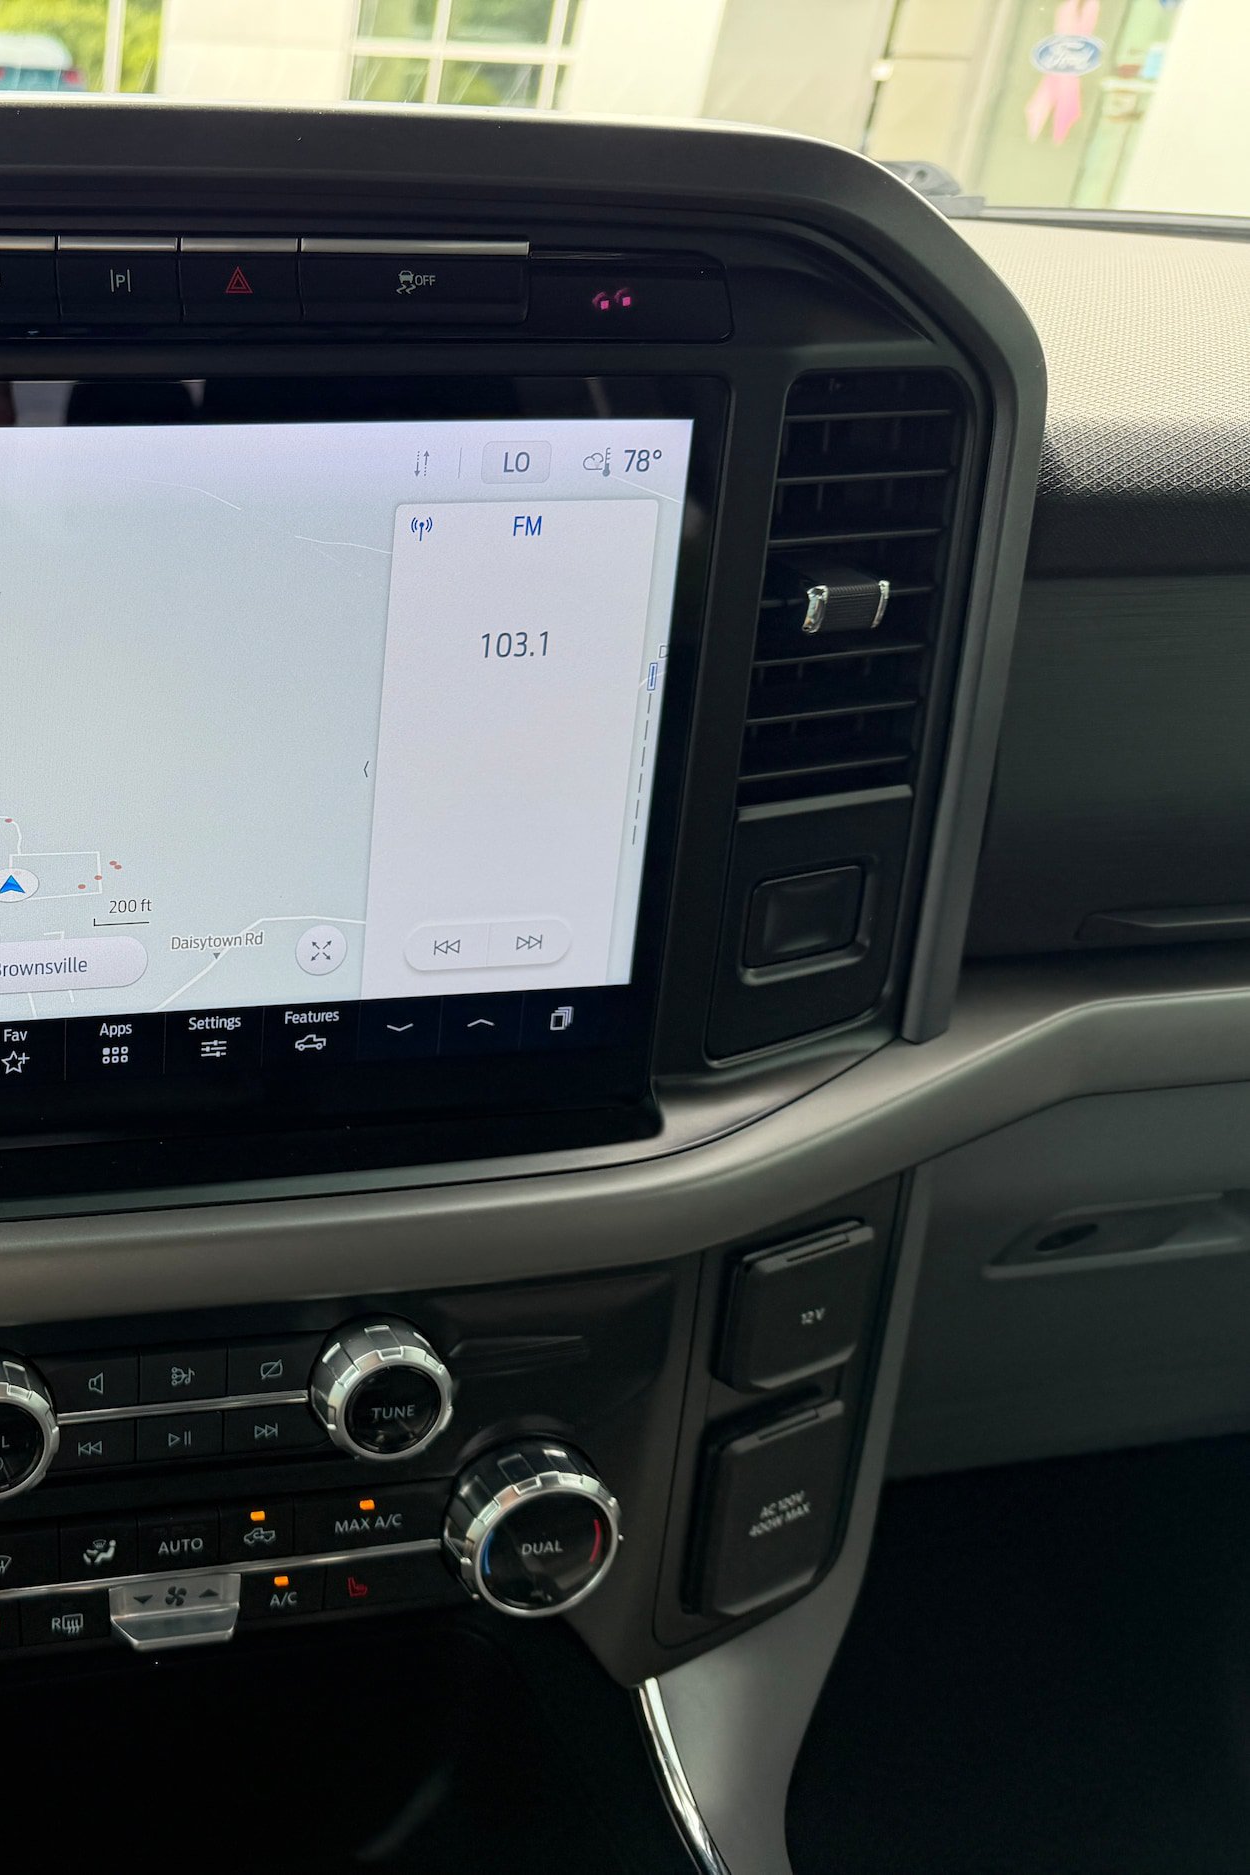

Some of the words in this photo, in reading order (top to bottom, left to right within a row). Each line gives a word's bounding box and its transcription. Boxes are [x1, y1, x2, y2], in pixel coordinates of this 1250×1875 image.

[414, 274, 436, 286] OFF
[503, 451, 530, 473] LO
[624, 449, 663, 473] 78°
[512, 515, 543, 537] FM
[481, 631, 549, 659] 103.1
[109, 899, 137, 914] 200
[140, 898, 152, 912] ft
[170, 935, 242, 952] Daisytown
[244, 931, 264, 947] Rd
[188, 1015, 242, 1031] Settings
[284, 1010, 340, 1025] Features
[3, 1028, 28, 1043] Fav
[99, 1022, 133, 1038] Apps
[371, 1404, 415, 1420] TUNE
[784, 1501, 812, 1523] MAX
[334, 1518, 370, 1533] MAX
[374, 1513, 402, 1529] A/C
[157, 1537, 204, 1555] AUTO
[520, 1539, 563, 1557] DUAL
[269, 1591, 297, 1607] A/C
